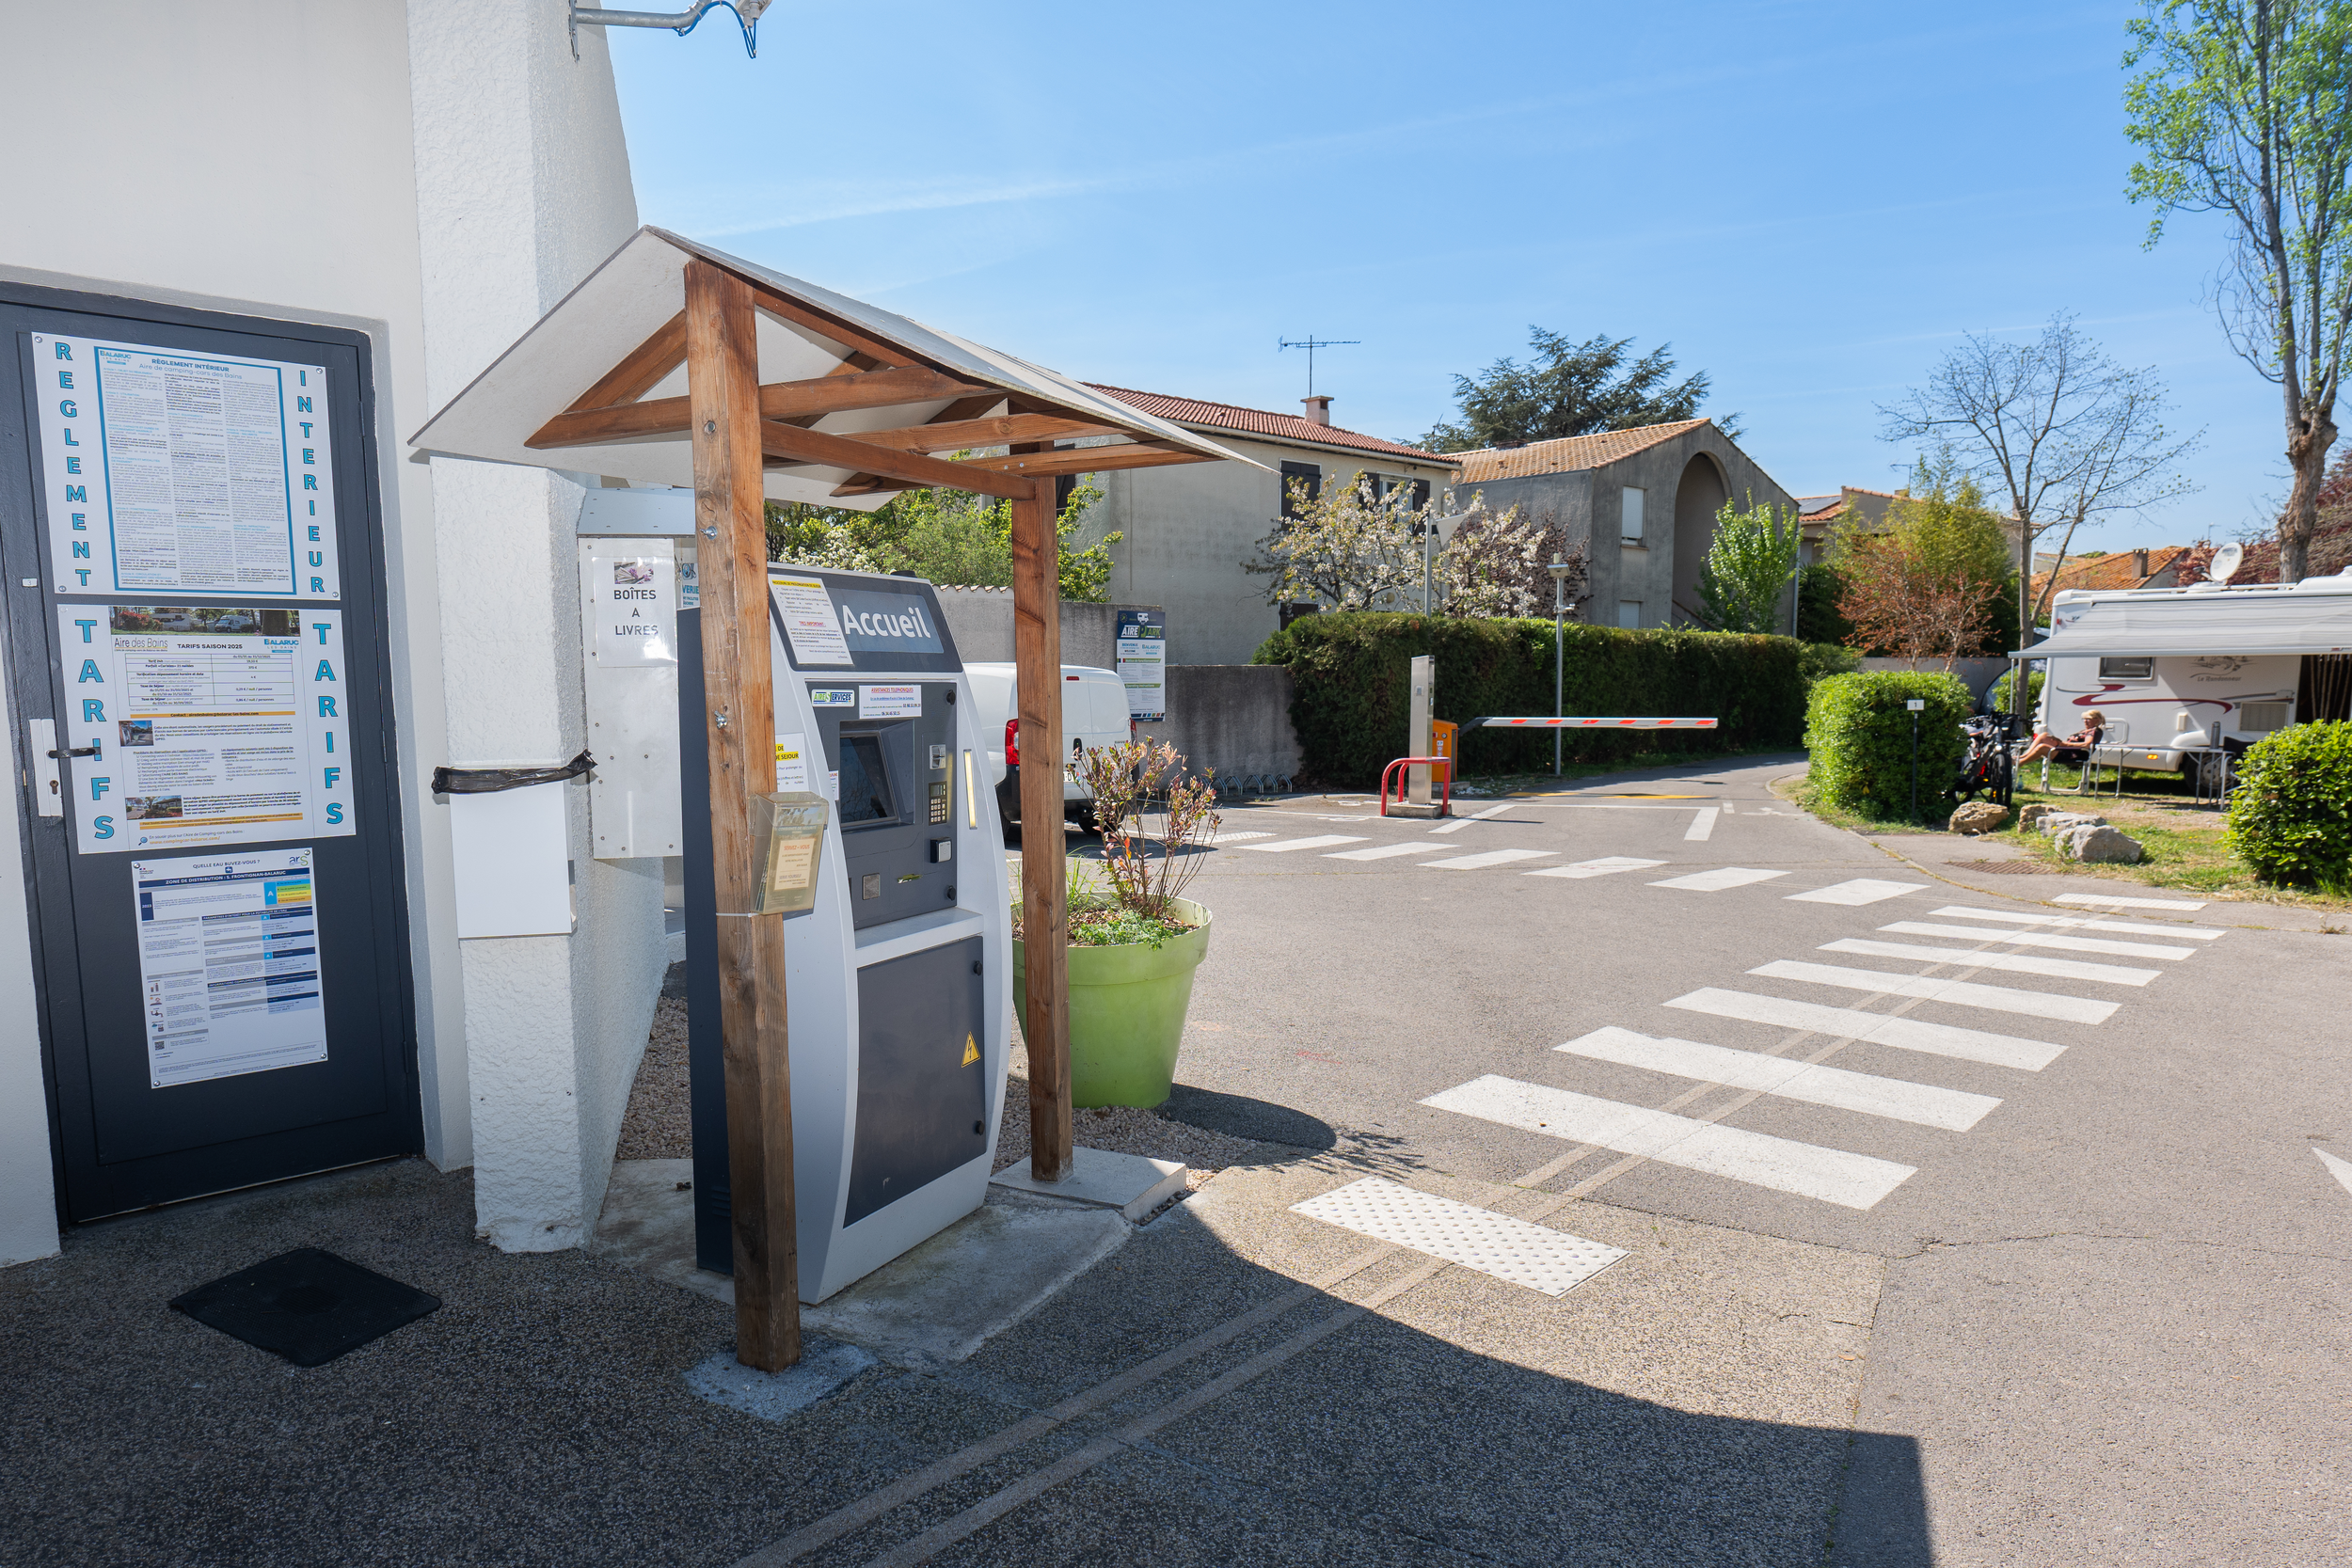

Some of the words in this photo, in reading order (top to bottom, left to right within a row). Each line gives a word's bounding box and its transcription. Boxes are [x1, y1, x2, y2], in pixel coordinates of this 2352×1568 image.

[100, 350, 131, 359] BALARUC
[151, 358, 193, 368] RÈGLEMENT
[194, 364, 230, 372] INTÉRIEUR
[164, 366, 211, 376] camping-cars
[55, 341, 91, 587] REGLEMENT
[297, 370, 326, 594] INTERIEUR
[614, 587, 656, 600] BOÎTES
[631, 608, 640, 618] A
[842, 604, 931, 639] Accueil
[615, 625, 658, 636] LIVRES
[114, 637, 130, 647] Aire
[132, 637, 145, 647] des
[147, 637, 168, 647] Bains
[74, 619, 115, 840] TARIFS
[312, 623, 343, 825] TARIFS
